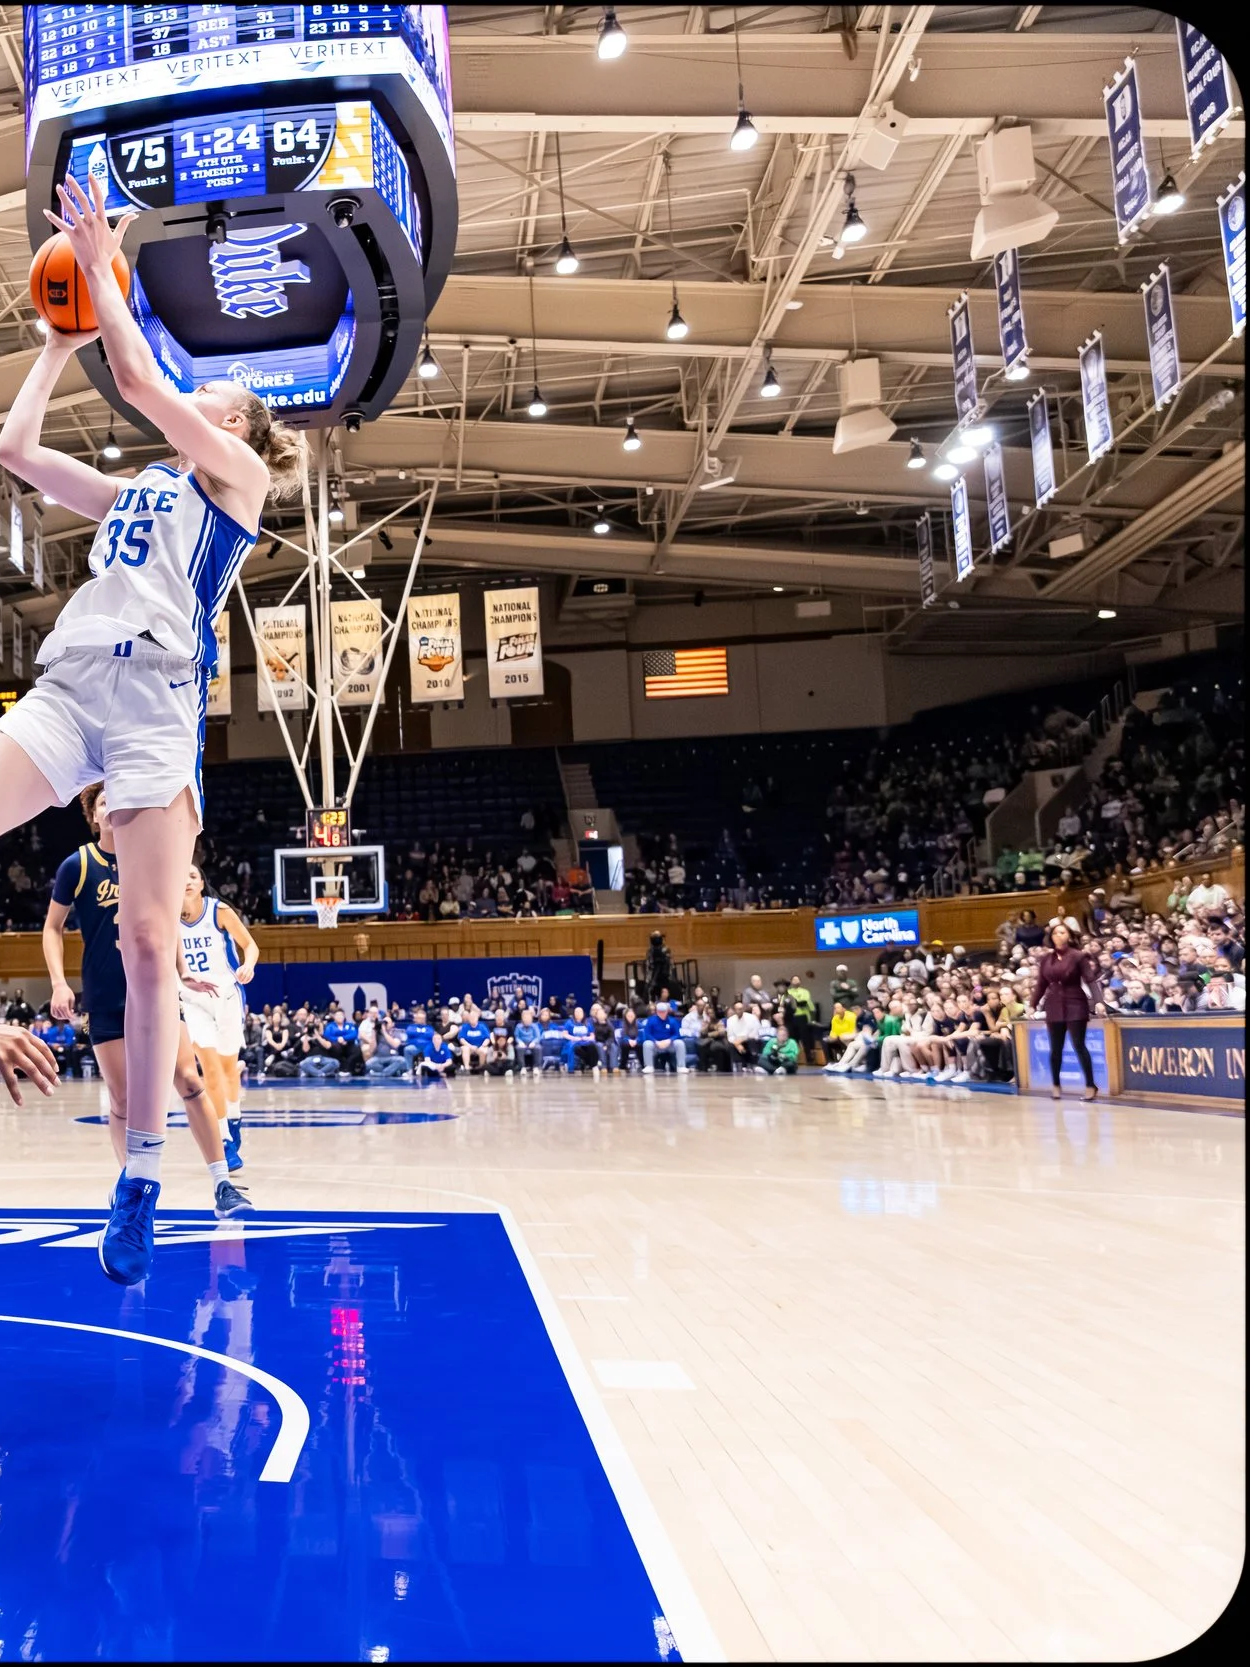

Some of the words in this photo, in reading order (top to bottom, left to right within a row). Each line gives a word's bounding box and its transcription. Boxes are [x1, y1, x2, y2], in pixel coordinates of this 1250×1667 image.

[44, 13, 54, 24] 4
[61, 7, 77, 20] 11
[143, 8, 178, 24] 8-13
[41, 30, 57, 44] 12
[61, 25, 77, 38] 10
[82, 19, 98, 33] 10
[107, 15, 116, 27] 2
[151, 26, 171, 40] 37
[256, 10, 276, 24] 31
[309, 22, 328, 35] 23
[332, 21, 350, 33] 10
[359, 20, 369, 32] 3
[382, 19, 392, 31] 1
[41, 47, 58, 61] 22
[62, 43, 78, 56] 21
[107, 34, 116, 46] 1
[152, 42, 171, 57] 18
[196, 34, 230, 50] AST
[256, 27, 276, 41] 12
[289, 41, 386, 59] VERITEXT
[41, 65, 58, 80] 35
[62, 60, 78, 75] 18
[86, 56, 95, 68] 7
[108, 52, 116, 64] 1
[166, 50, 262, 74] VERITEXT
[51, 68, 140, 98] VERITEXT
[179, 123, 261, 159] 1:24
[272, 118, 320, 152] 64
[121, 136, 166, 173] 75
[272, 155, 306, 167] Fouls:
[307, 154, 315, 164] 4
[192, 165, 248, 180] TIMEOUTS
[128, 177, 159, 190] Fouls:
[206, 177, 234, 188] POSS
[233, 367, 263, 379] Duke
[113, 487, 179, 514] UKE
[493, 601, 531, 612] NATIONAL
[490, 611, 537, 625] CHAMPIONS
[263, 630, 303, 640] HAMPIONS
[504, 673, 529, 685] 2015
[348, 683, 370, 694] 2001
[861, 917, 899, 932] North
[182, 936, 212, 950] UKE
[862, 927, 917, 944] Carolina
[184, 951, 210, 973] 22
[1129, 1046, 1215, 1078] CAMERON
